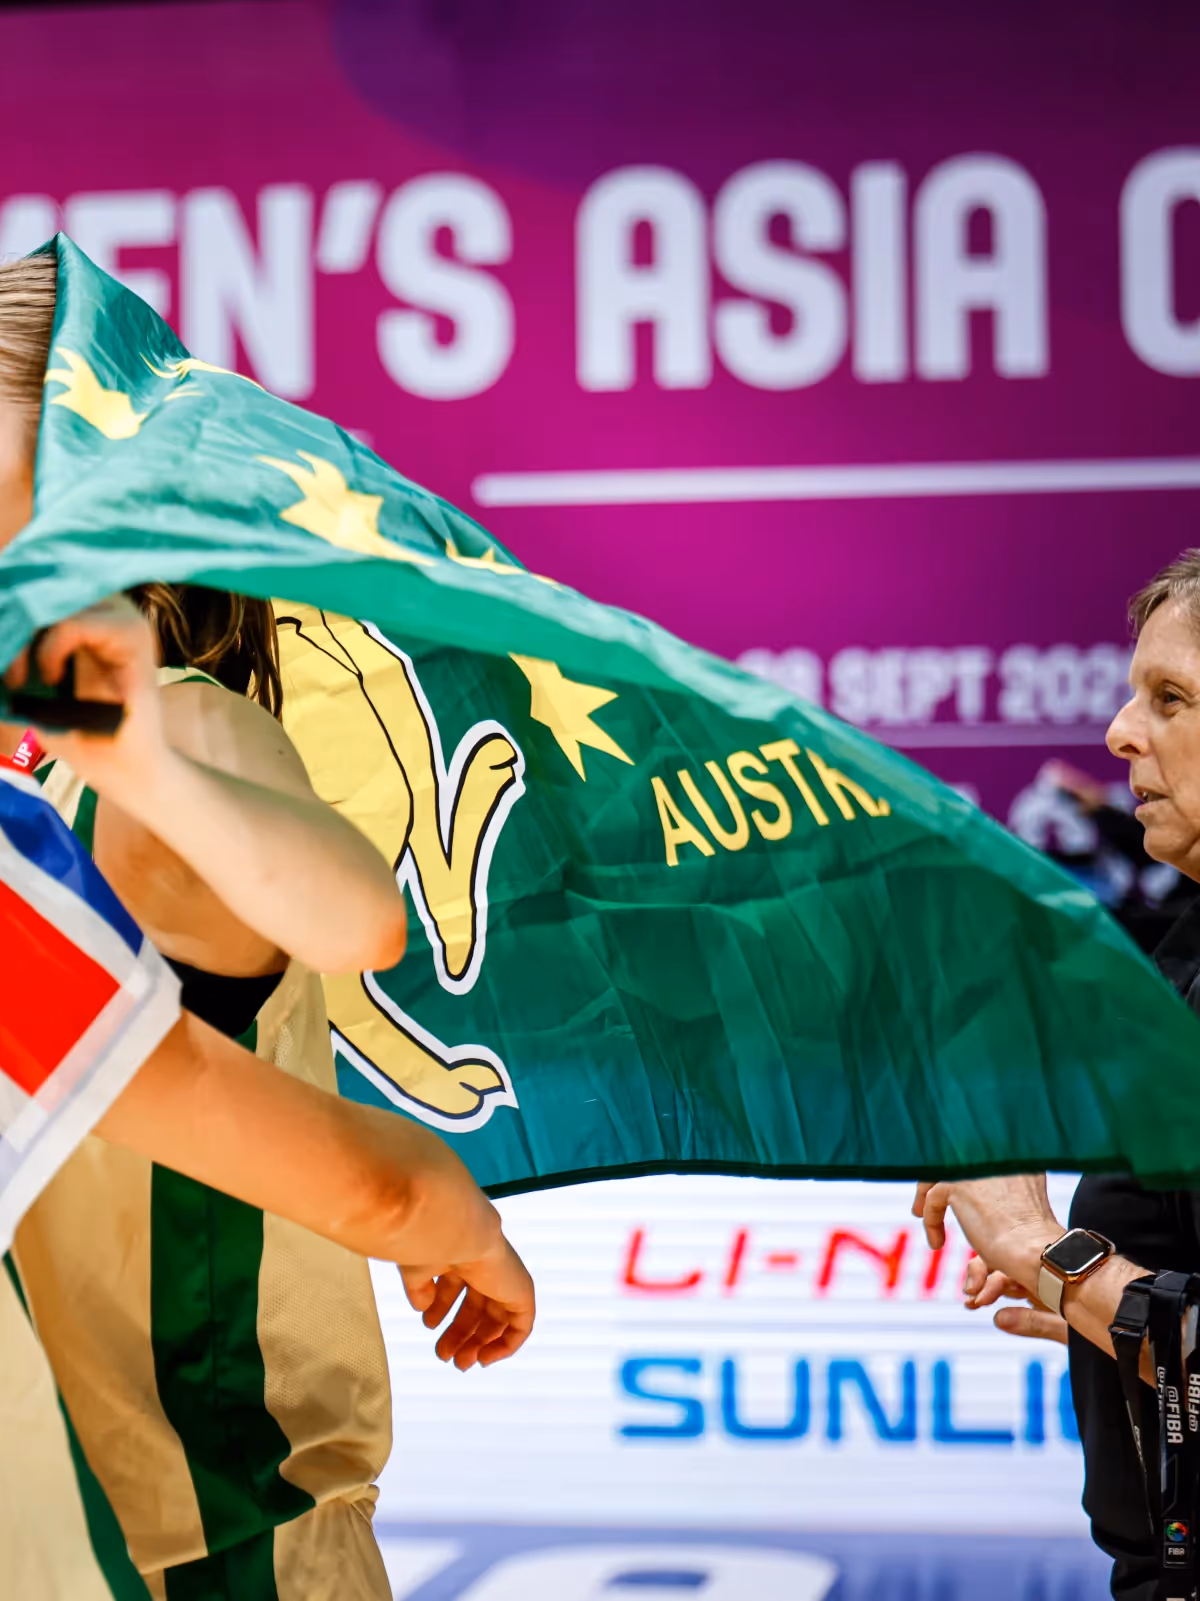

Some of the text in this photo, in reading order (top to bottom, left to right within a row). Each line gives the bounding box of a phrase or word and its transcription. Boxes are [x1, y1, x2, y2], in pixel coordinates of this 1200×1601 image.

[574, 151, 1050, 392] ASIA
[999, 643, 1135, 724] 202
[650, 738, 891, 867] AUSTR
[621, 1224, 978, 1298] LI-NI
[1166, 1385, 1184, 1444] @FIBA
[1168, 1547, 1185, 1556] FIBA
